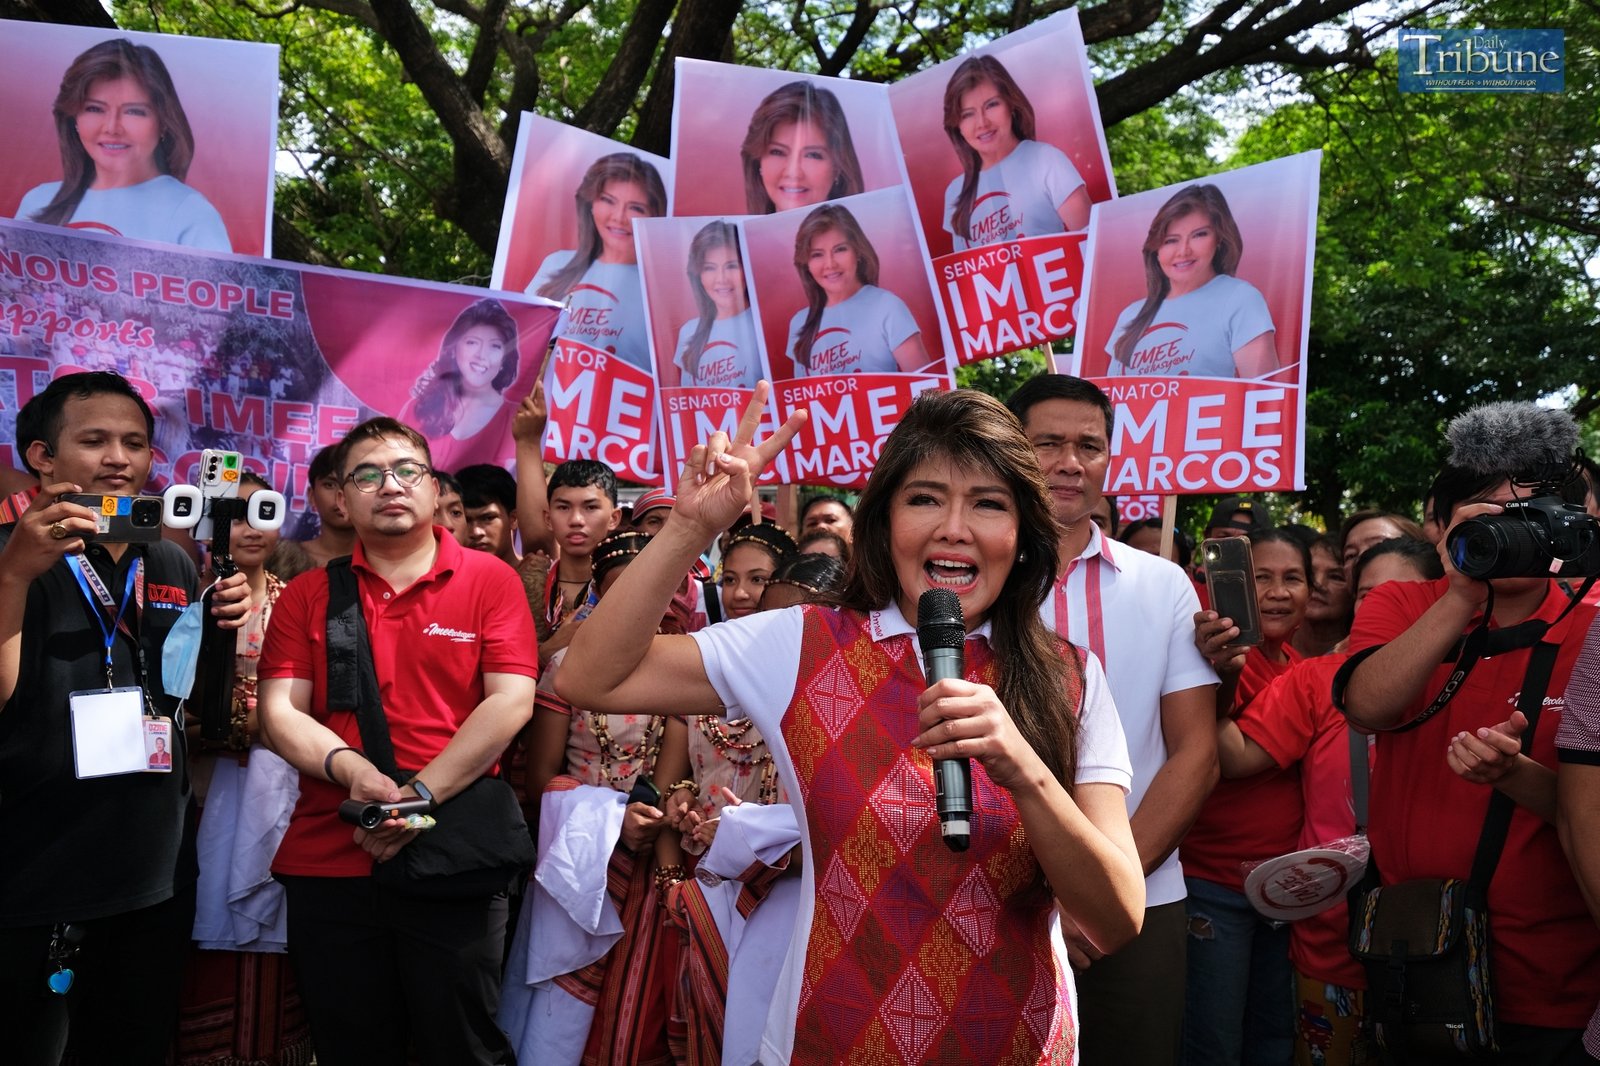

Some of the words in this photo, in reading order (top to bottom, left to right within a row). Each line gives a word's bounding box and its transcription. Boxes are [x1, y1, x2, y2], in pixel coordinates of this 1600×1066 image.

[971, 204, 1010, 242] IMEE
[944, 244, 1023, 281] SENATOR
[132, 270, 295, 321] PEOPLE
[947, 240, 1088, 330] IME
[0, 303, 155, 348] pports
[567, 306, 613, 326] MEE
[959, 297, 1081, 360] MARC
[699, 355, 736, 381] IMEE
[811, 340, 849, 371] IMEE
[1130, 337, 1183, 370] IMEE
[668, 391, 742, 412] SENATOR
[783, 377, 859, 404] SENATOR
[1102, 380, 1180, 402] ENATOR
[185, 387, 359, 447] IMEE
[1110, 387, 1285, 457] MEE
[1505, 501, 1529, 509] Canon
[1438, 670, 1465, 703] EOS
